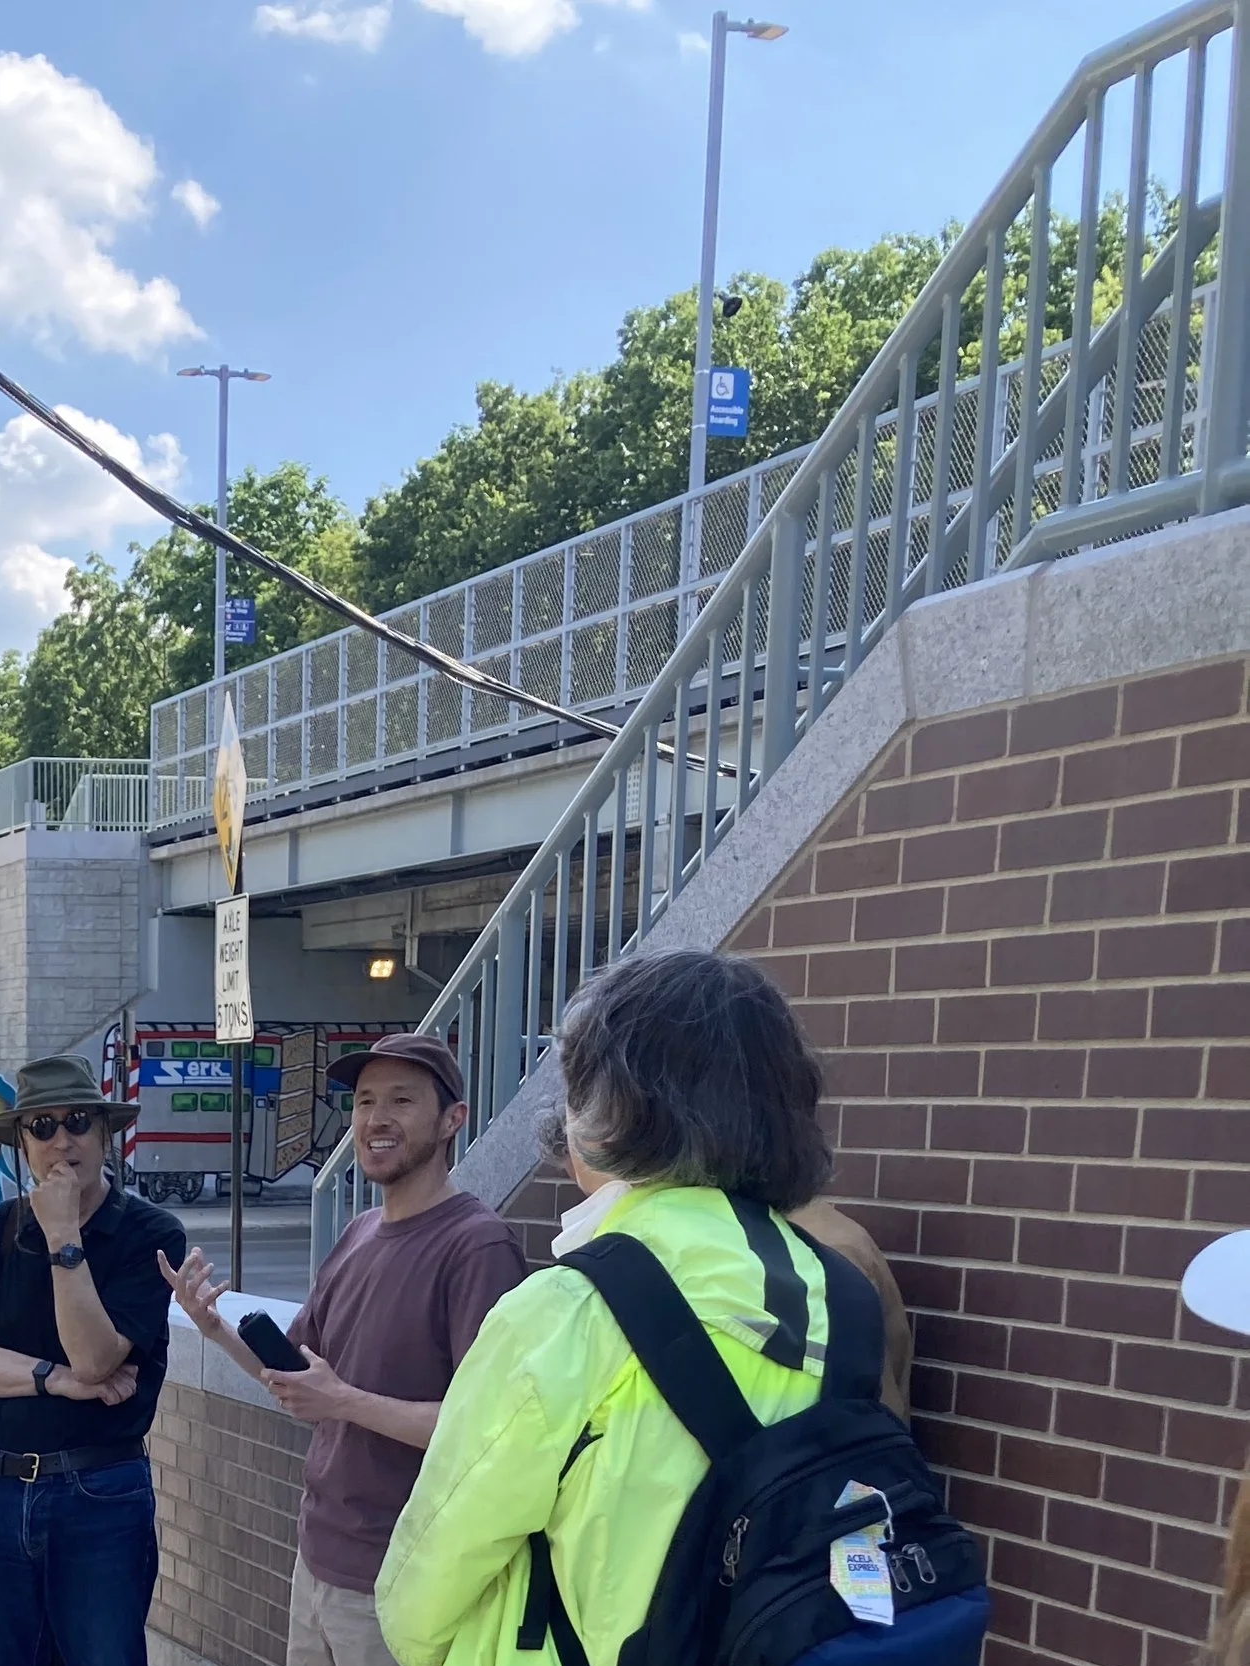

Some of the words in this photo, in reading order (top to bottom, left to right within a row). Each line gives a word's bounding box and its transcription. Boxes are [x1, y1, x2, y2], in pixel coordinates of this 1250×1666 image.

[222, 909, 240, 934] AXLE
[219, 939, 243, 964] WEIGHT
[222, 970, 239, 992] LIMIT
[217, 1003, 223, 1029] 5
[224, 1001, 249, 1028] TONS
[846, 1554, 873, 1564] ACELA
[847, 1563, 880, 1572] EXPRESS
